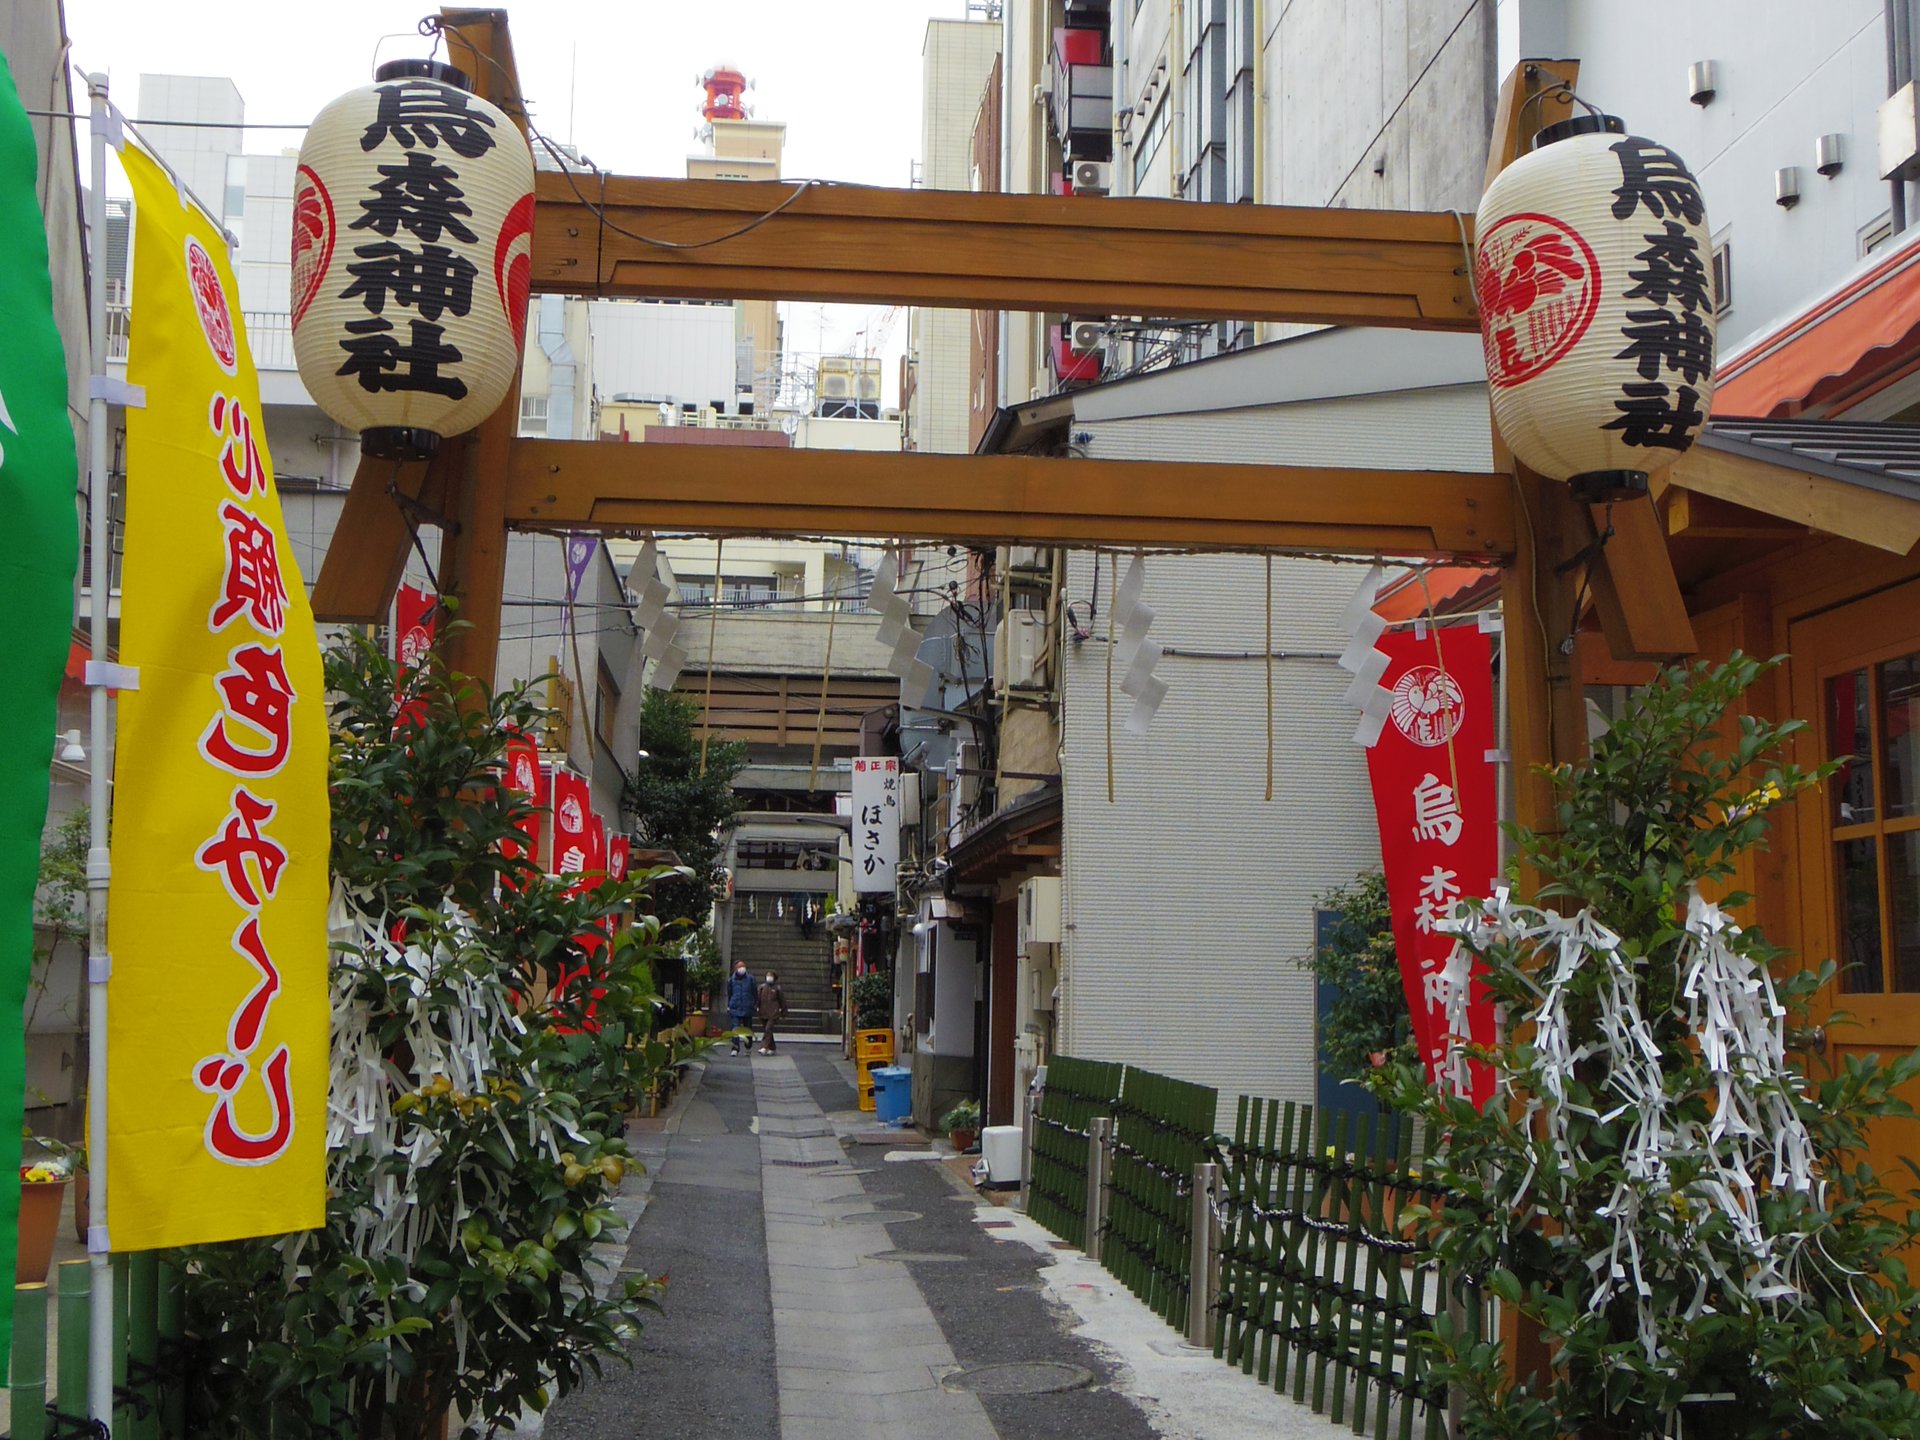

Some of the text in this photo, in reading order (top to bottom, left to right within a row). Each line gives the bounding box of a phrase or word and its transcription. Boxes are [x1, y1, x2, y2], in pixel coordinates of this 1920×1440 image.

[336, 81, 497, 401] 烏森神社
[1600, 136, 1713, 453] 烏森神社
[855, 760, 897, 773] 菊正宗
[862, 805, 885, 875] ほさか
